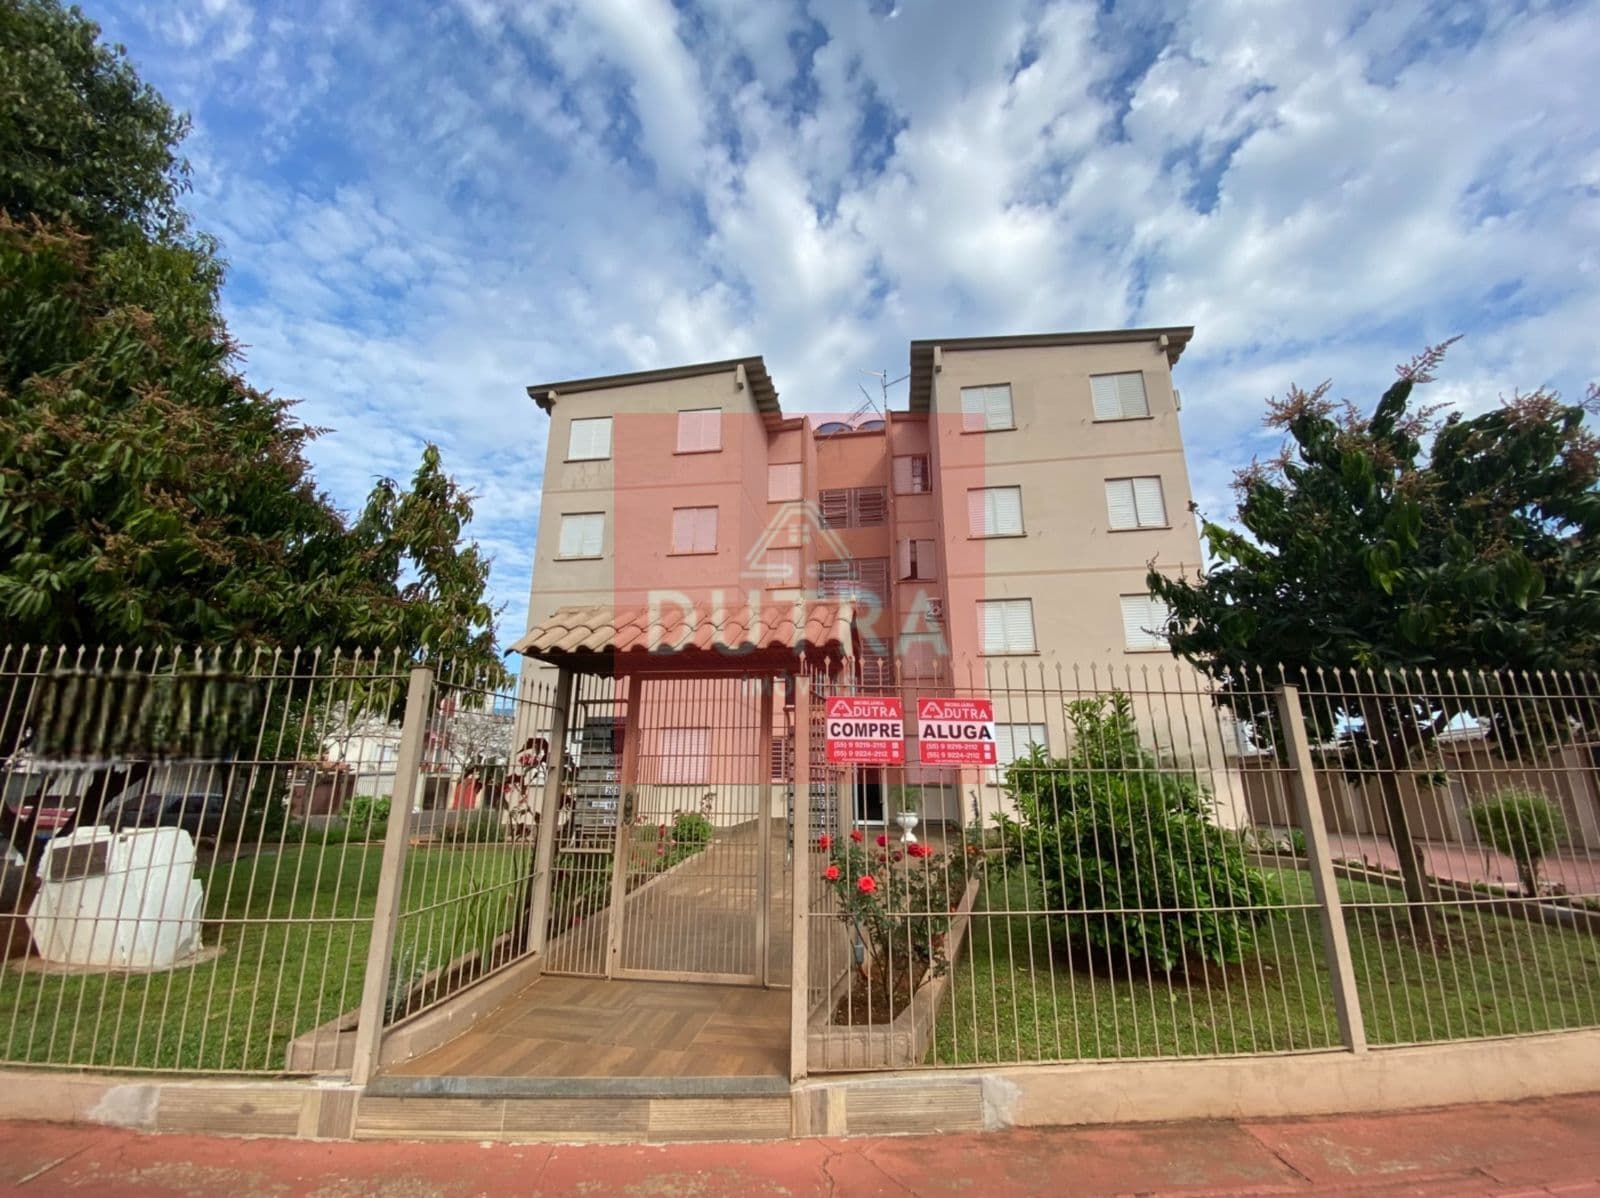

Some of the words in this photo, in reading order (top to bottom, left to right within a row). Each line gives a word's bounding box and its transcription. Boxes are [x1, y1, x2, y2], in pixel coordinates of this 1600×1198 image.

[853, 706, 898, 718] DUTRA
[944, 708, 989, 720] DUTRA
[830, 722, 901, 738] COMPRE
[922, 724, 993, 740] ALUGA
